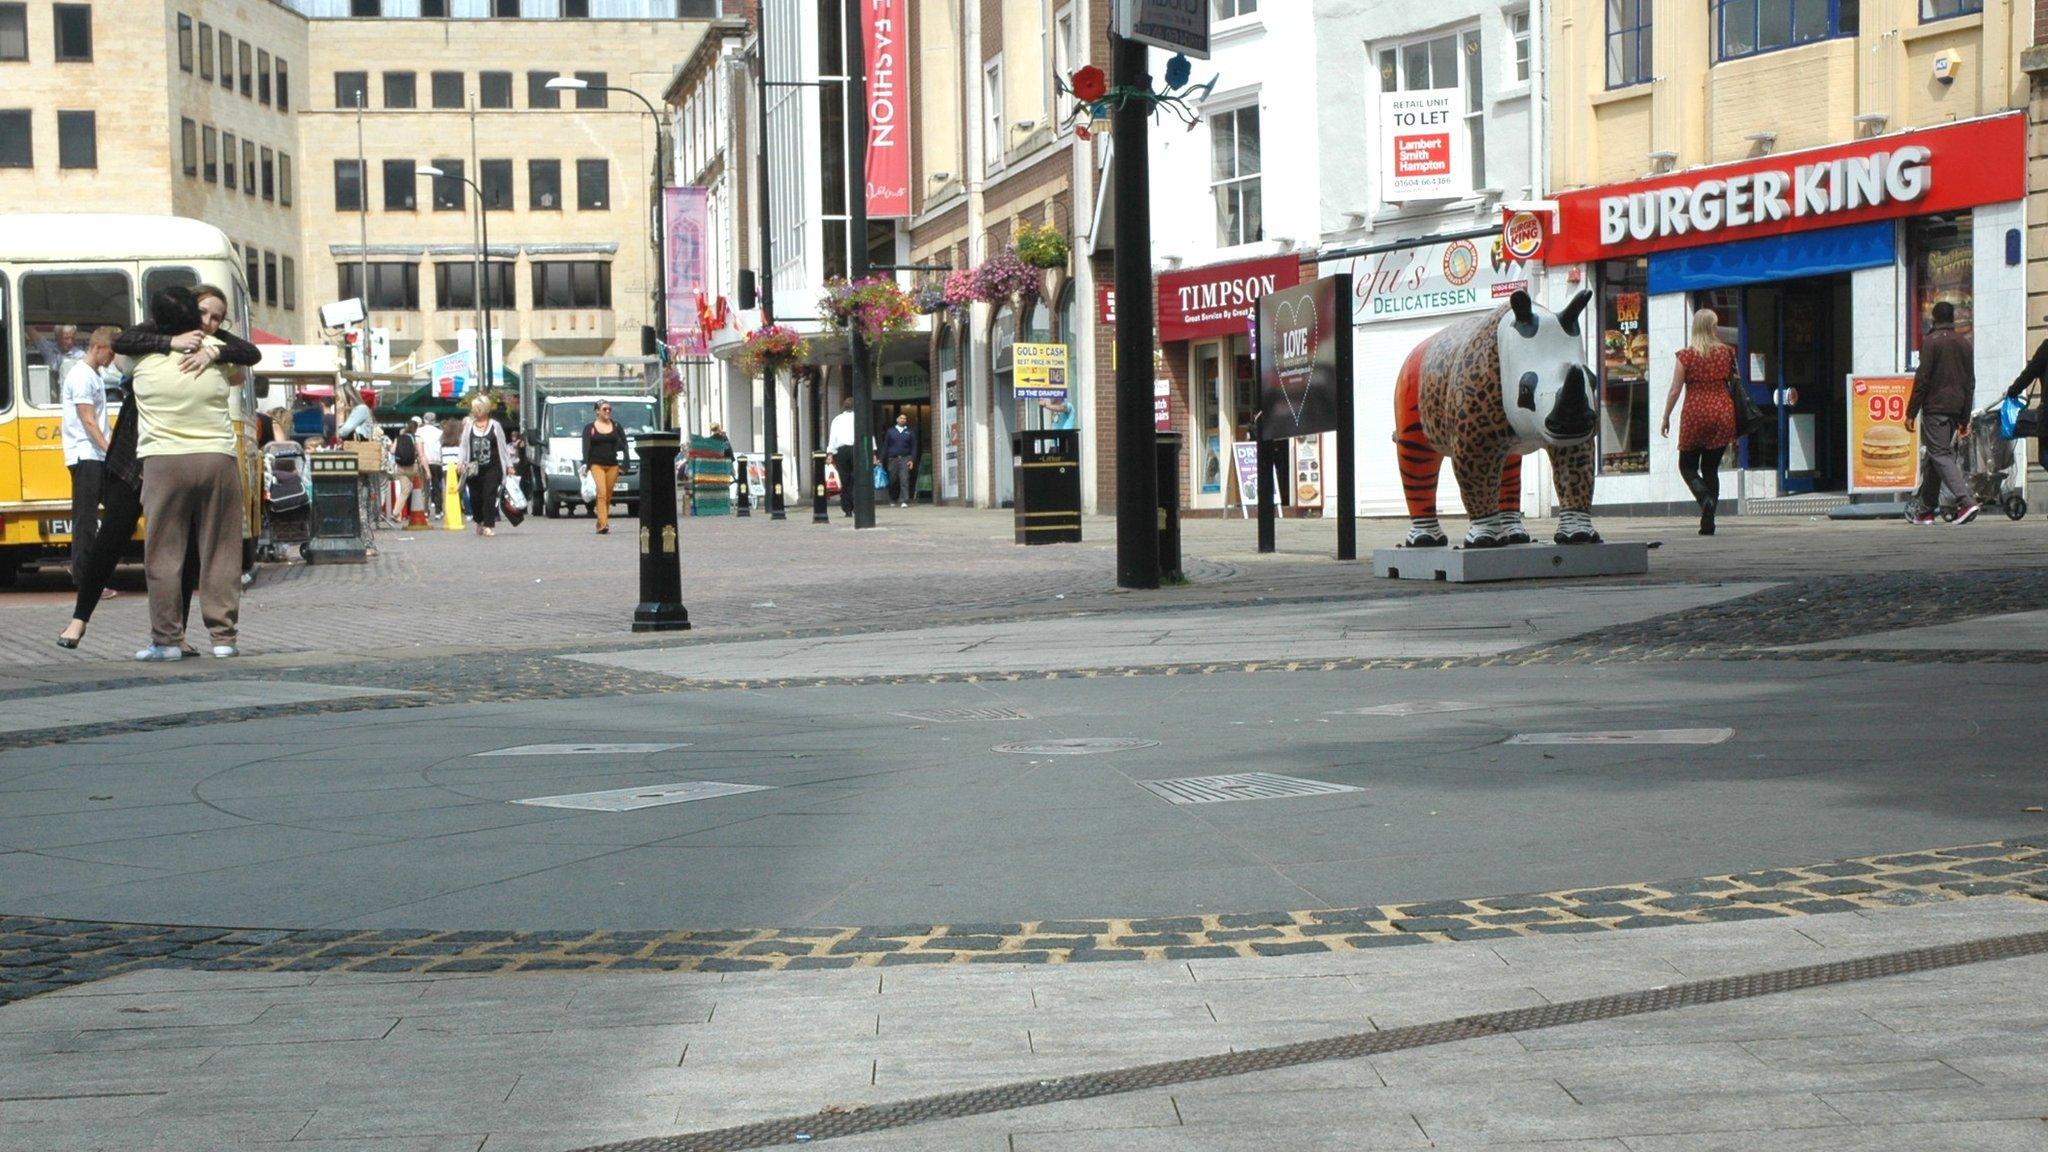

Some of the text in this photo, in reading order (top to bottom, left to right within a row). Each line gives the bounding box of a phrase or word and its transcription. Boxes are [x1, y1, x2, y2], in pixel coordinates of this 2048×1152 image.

[871, 19, 894, 147] FASHION
[1393, 98, 1449, 109] RETAIL UNIT
[1394, 111, 1449, 126] TO LET
[1399, 139, 1442, 151] Lambert
[1400, 149, 1429, 161] Smith
[1400, 160, 1446, 172] Hampton
[1601, 145, 1931, 245] BURGER KING
[1510, 219, 1537, 236] BURGER
[1511, 228, 1538, 247] KING
[1179, 275, 1276, 311] TIMPSON
[1373, 288, 1476, 315] DELICATESSEN
[1184, 314, 1200, 323] Great
[1201, 312, 1223, 321] Service
[1224, 310, 1231, 319] By
[1232, 308, 1249, 317] Great
[1617, 309, 1639, 322] DAY
[1017, 347, 1037, 356] GOLD
[1046, 347, 1065, 356] CASH
[1283, 328, 1308, 359] LOVE
[1868, 394, 1906, 423] 99
